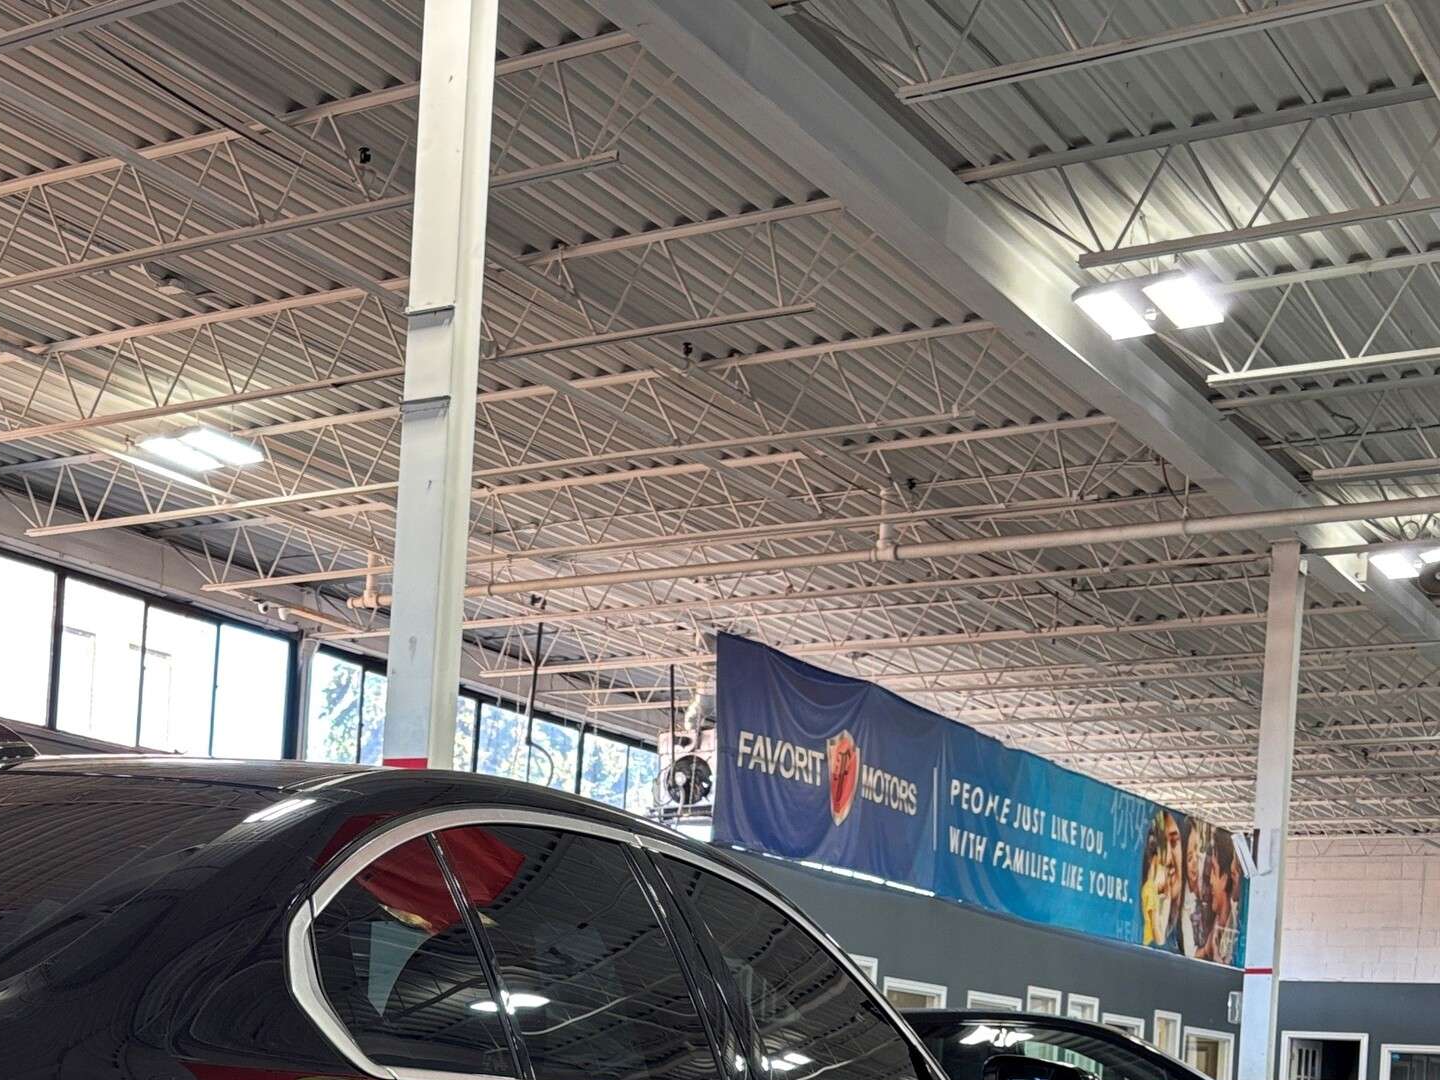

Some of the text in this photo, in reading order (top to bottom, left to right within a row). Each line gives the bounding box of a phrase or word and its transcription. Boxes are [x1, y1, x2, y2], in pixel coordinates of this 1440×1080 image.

[737, 730, 825, 786] FAVORIT
[860, 764, 918, 816] MOTORS
[949, 825, 1134, 904] WITH FAMILIES LIKE YOURS.
[1013, 803, 1046, 836] JUST
[1050, 814, 1078, 846] LIKE
[1080, 825, 1108, 860] YOU,
